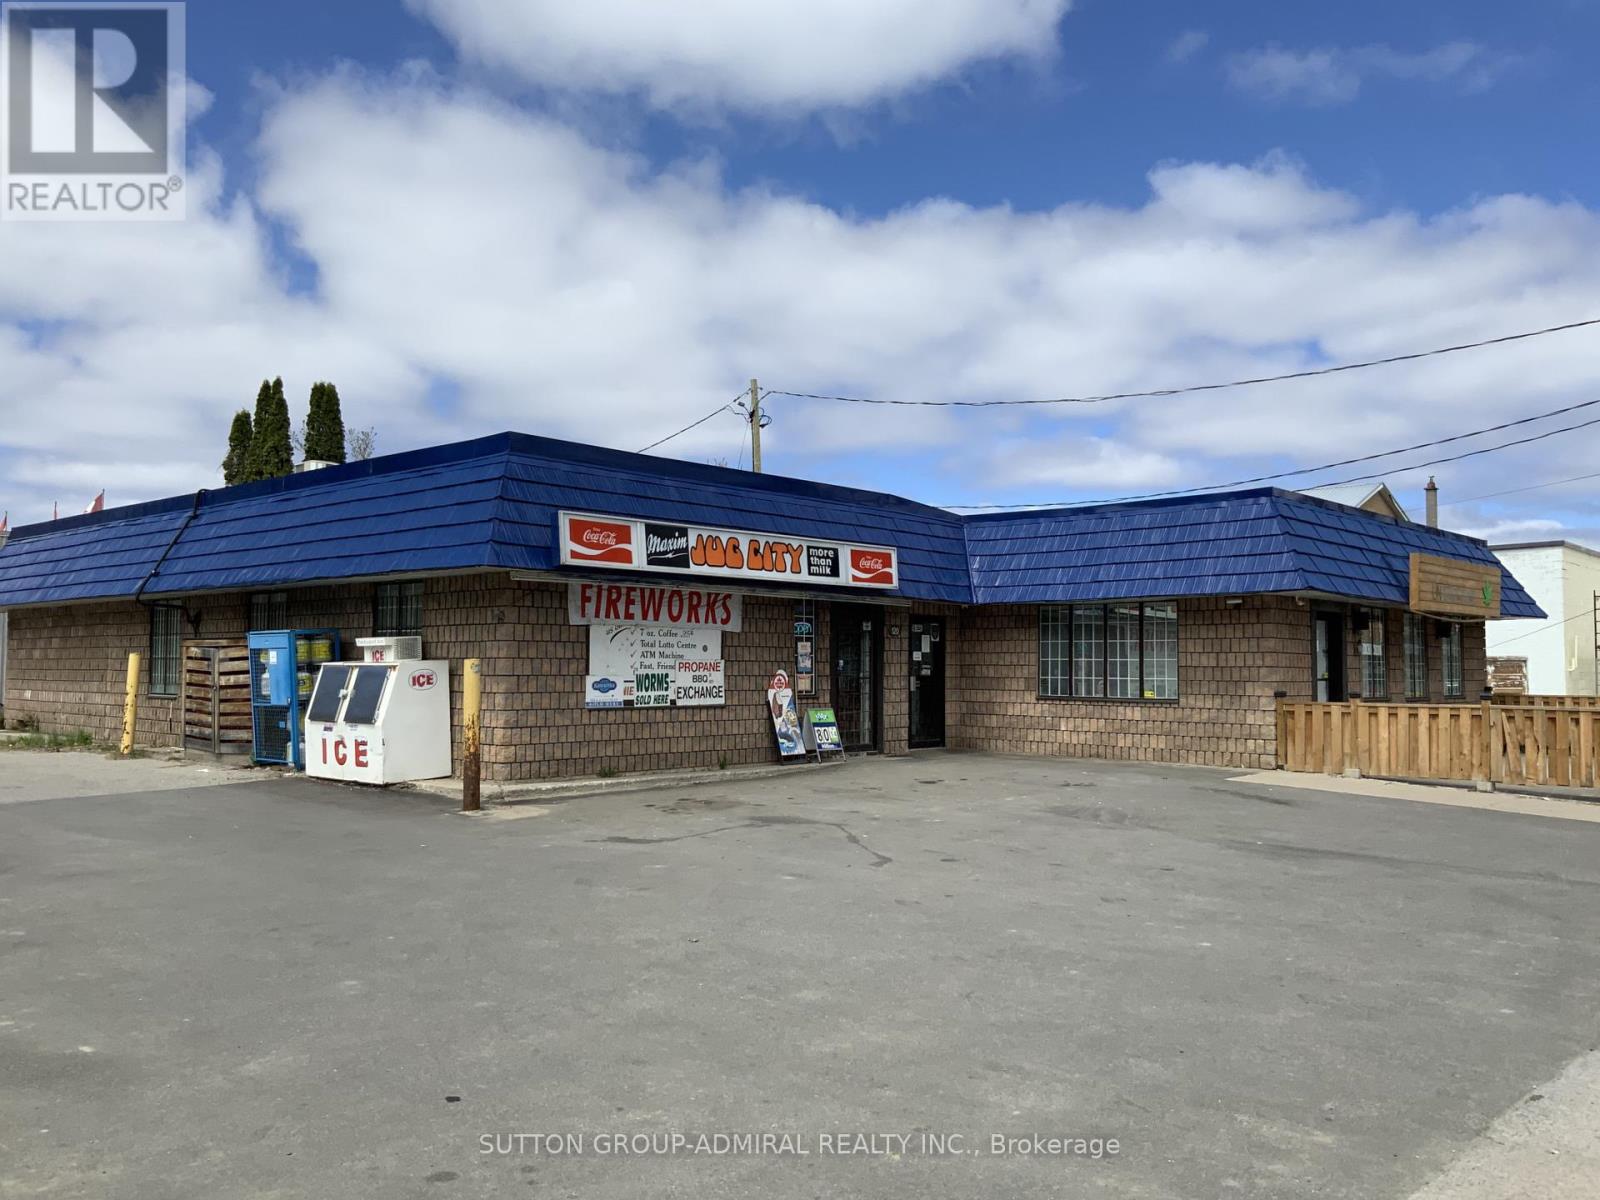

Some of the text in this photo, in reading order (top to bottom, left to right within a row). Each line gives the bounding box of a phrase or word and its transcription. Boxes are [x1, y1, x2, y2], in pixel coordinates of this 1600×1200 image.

[646, 531, 689, 556] Maxim
[690, 533, 804, 574] JUG CITY
[809, 548, 834, 557] more
[810, 556, 832, 566] than
[810, 565, 831, 575] milk
[580, 583, 732, 625] FIREWORKS
[658, 629, 678, 638] Coffee
[640, 640, 697, 649] Total Lotto Centre
[372, 649, 385, 662] ICE
[640, 651, 685, 660] ATM Machine
[640, 662, 655, 670] Fast,
[678, 661, 721, 673] PROPANE
[412, 673, 434, 688] ICE
[635, 672, 669, 693] WORMS
[692, 674, 708, 683] BBQ
[676, 685, 723, 699] EXCHANGE
[635, 695, 651, 706] SOLD
[653, 694, 669, 705] HERE
[322, 737, 369, 768] ICE
